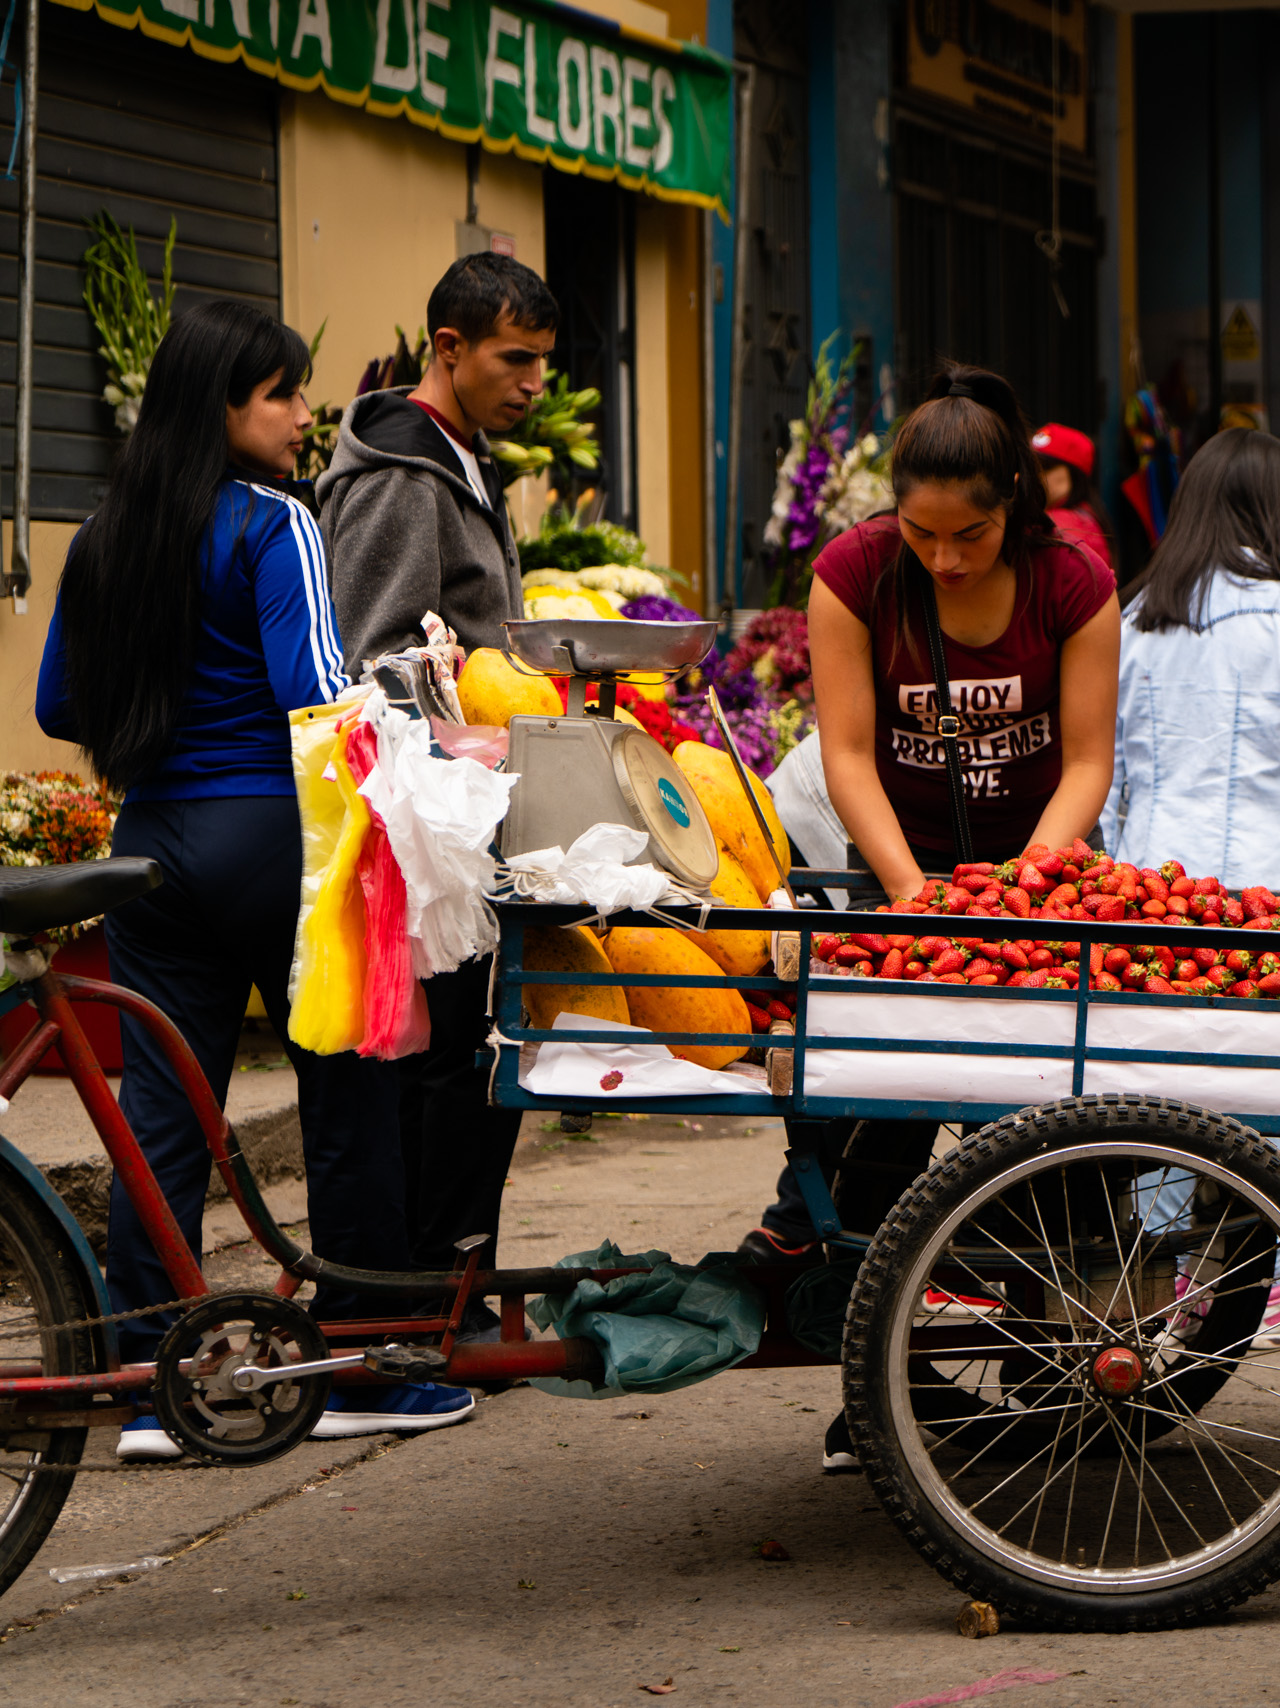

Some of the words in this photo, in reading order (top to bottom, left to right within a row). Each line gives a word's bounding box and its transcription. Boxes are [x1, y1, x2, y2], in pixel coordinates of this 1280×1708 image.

[372, 0, 451, 110] DE
[484, 6, 676, 173] FLORES
[906, 684, 1012, 715] ENJOY
[896, 717, 1046, 765] PROBLEMS
